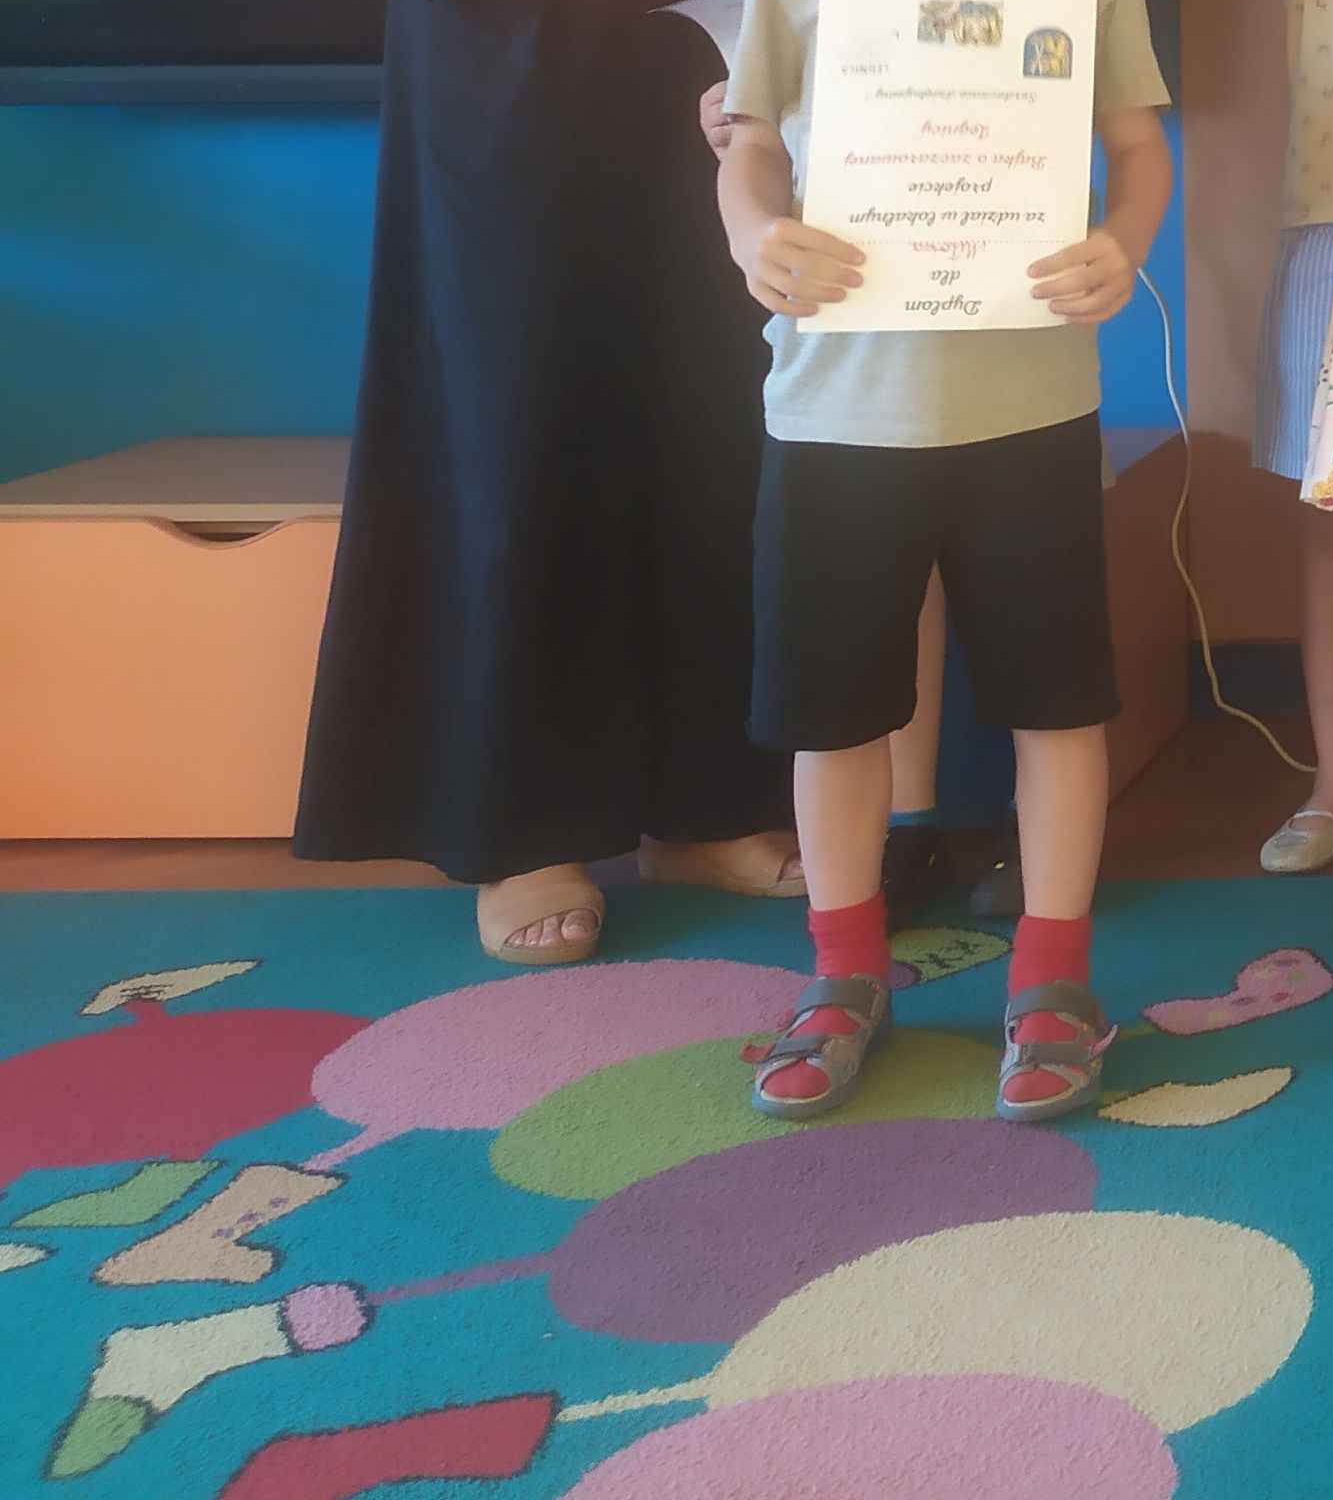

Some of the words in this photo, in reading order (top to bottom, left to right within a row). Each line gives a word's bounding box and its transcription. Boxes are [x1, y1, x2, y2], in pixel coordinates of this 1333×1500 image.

[907, 174, 993, 195] projekcie
[849, 206, 936, 228] lokalnym
[939, 210, 957, 223] w
[1023, 210, 1048, 224] za
[928, 268, 961, 286] dla
[904, 296, 984, 317] Dyplom
